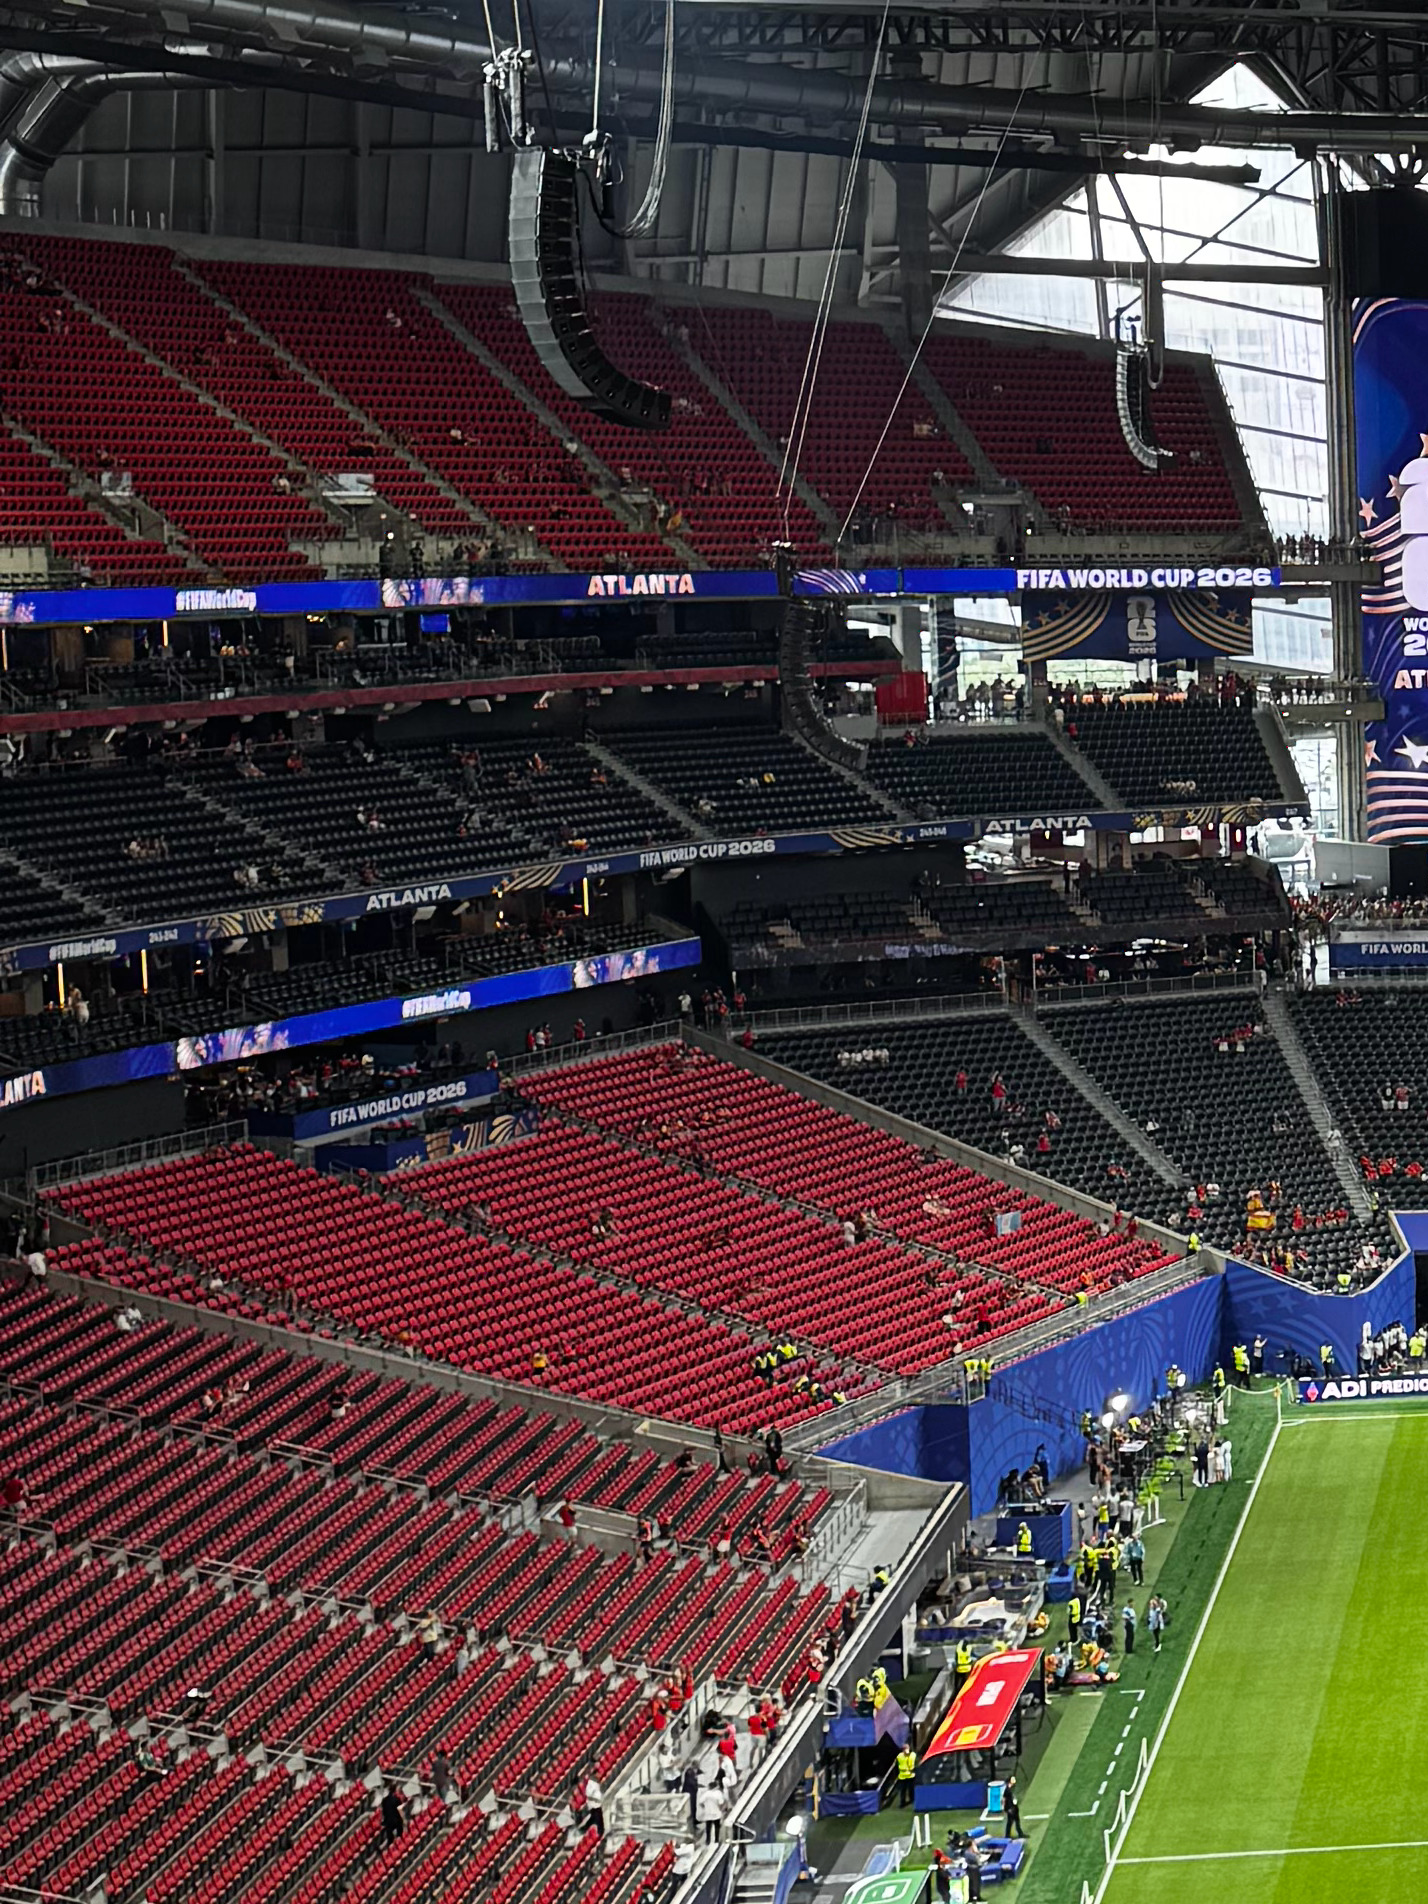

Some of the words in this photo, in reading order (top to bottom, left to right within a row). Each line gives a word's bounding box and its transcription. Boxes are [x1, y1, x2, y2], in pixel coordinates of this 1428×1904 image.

[587, 573, 695, 596] ATLANTA
[1016, 568, 1066, 589] FIFA
[1067, 568, 1149, 589] WORLD
[1151, 568, 1195, 589] CUP
[1197, 568, 1272, 589] 2026
[985, 815, 1093, 833] ATLANTA
[639, 850, 662, 868] FIFA
[661, 847, 698, 865] WORLD
[699, 843, 727, 861] CUP
[727, 839, 776, 857] 2026
[366, 883, 452, 911] ATLANTA
[1361, 942, 1391, 955] FIFA
[329, 1107, 357, 1128] FIFA
[357, 1096, 402, 1120] WORLD
[402, 1091, 425, 1111] CUP
[426, 1080, 467, 1104] 2026
[1321, 1379, 1367, 1400] ADI
